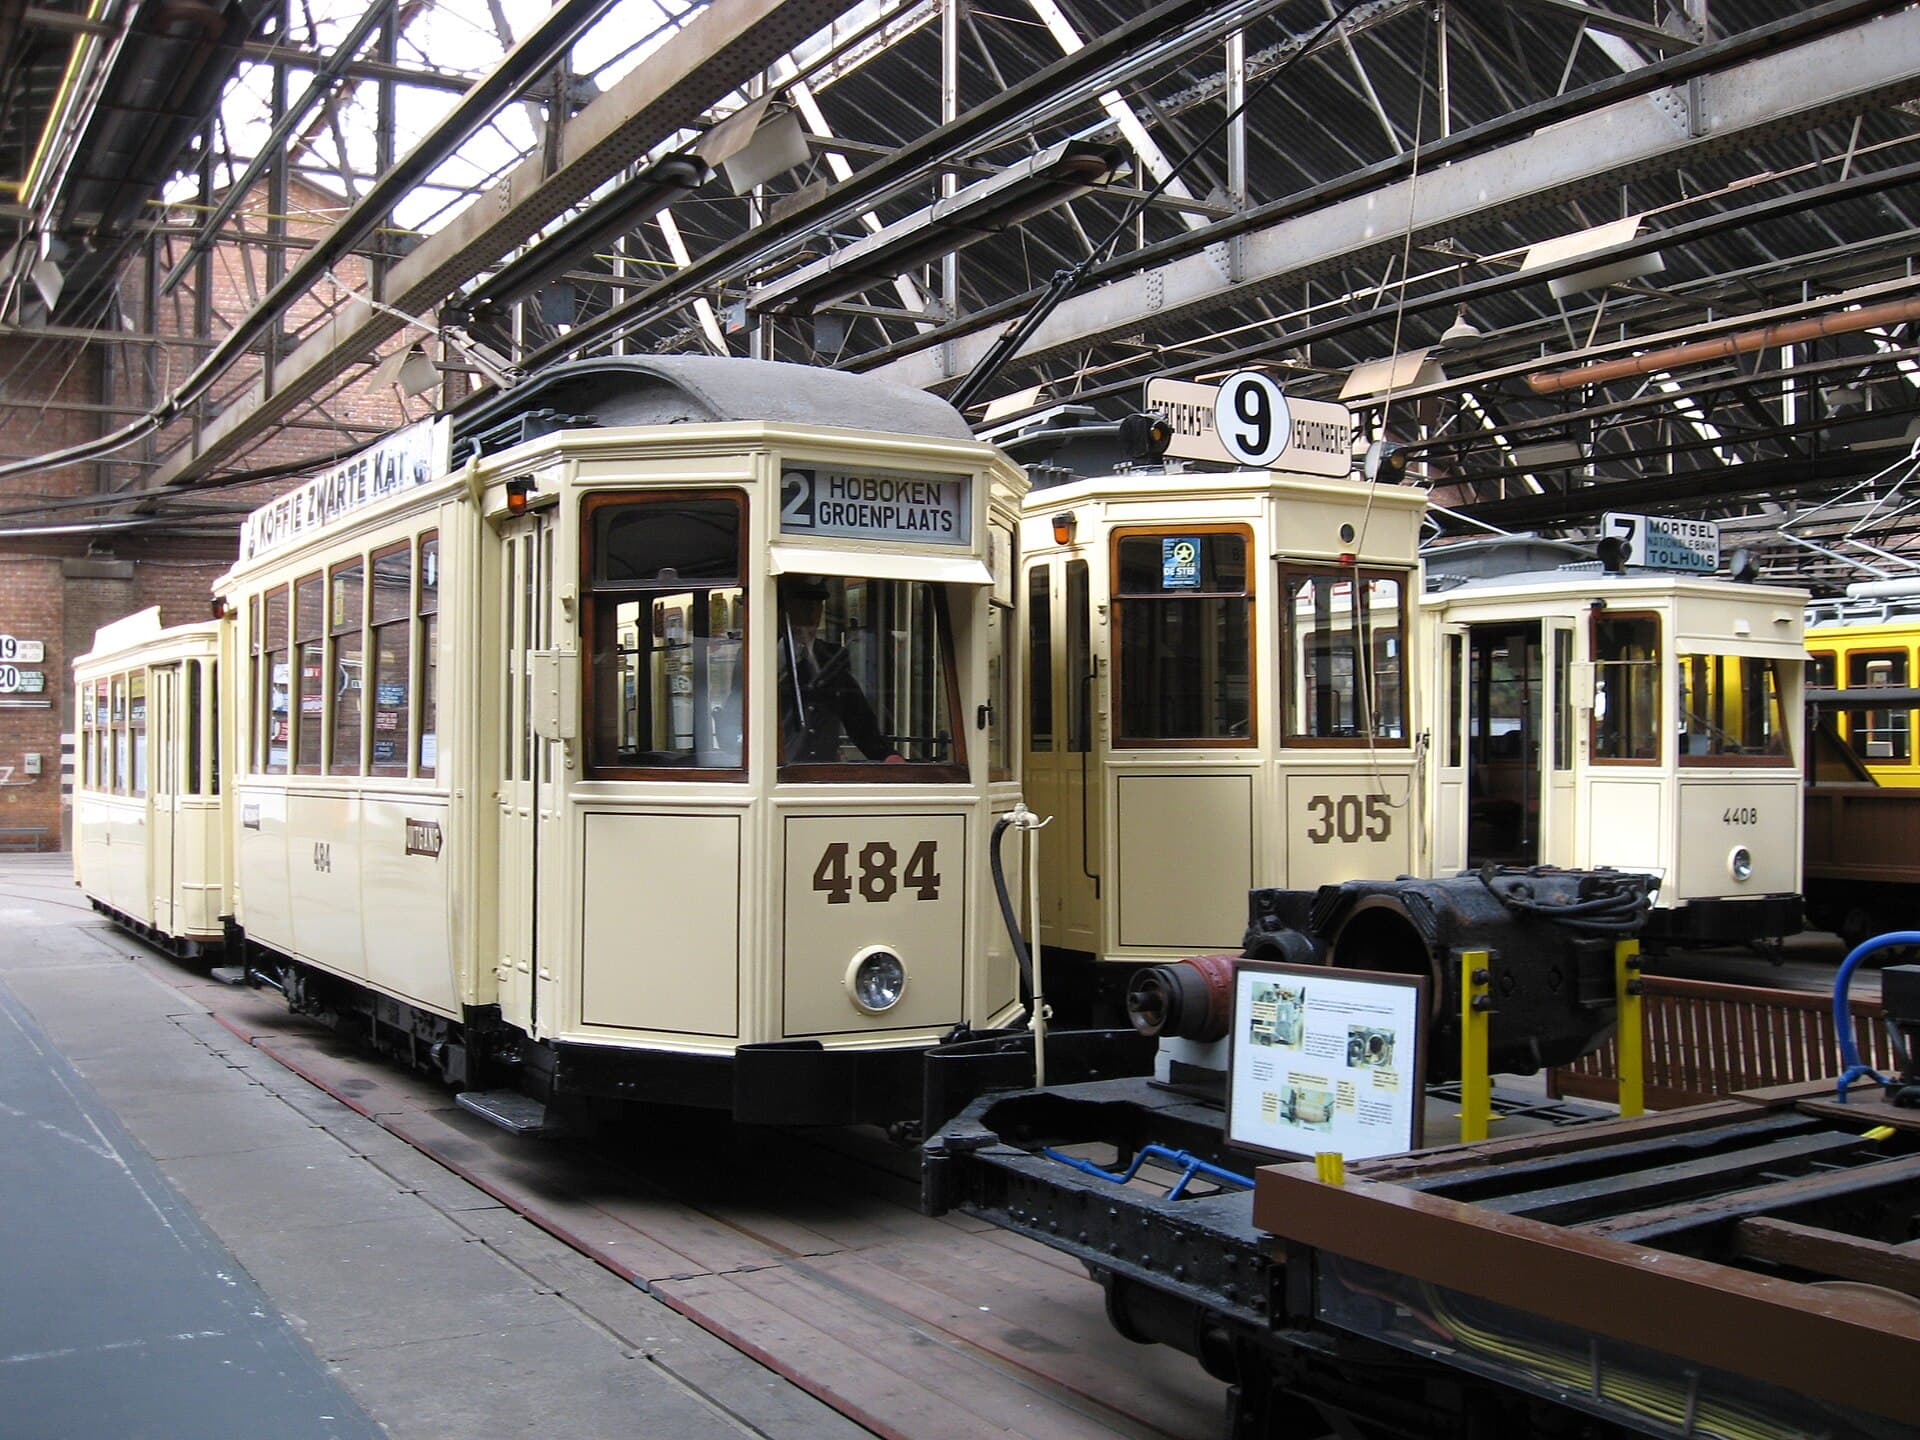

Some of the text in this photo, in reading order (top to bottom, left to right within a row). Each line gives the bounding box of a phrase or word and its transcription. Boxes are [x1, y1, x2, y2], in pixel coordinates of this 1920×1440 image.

[1234, 379, 1272, 457] 9
[259, 492, 303, 549] KOFFIE
[306, 458, 368, 527] ZWARTE
[781, 472, 812, 527] 2
[829, 475, 942, 506] HOBOKEN
[818, 500, 953, 532] GROENPLAATS
[1649, 520, 1715, 539] MORTSEL
[1649, 550, 1716, 568] TOLHUIS
[1306, 794, 1392, 844] 305
[1722, 807, 1758, 825] 4408
[313, 841, 331, 874] 484
[812, 840, 941, 905] 484
